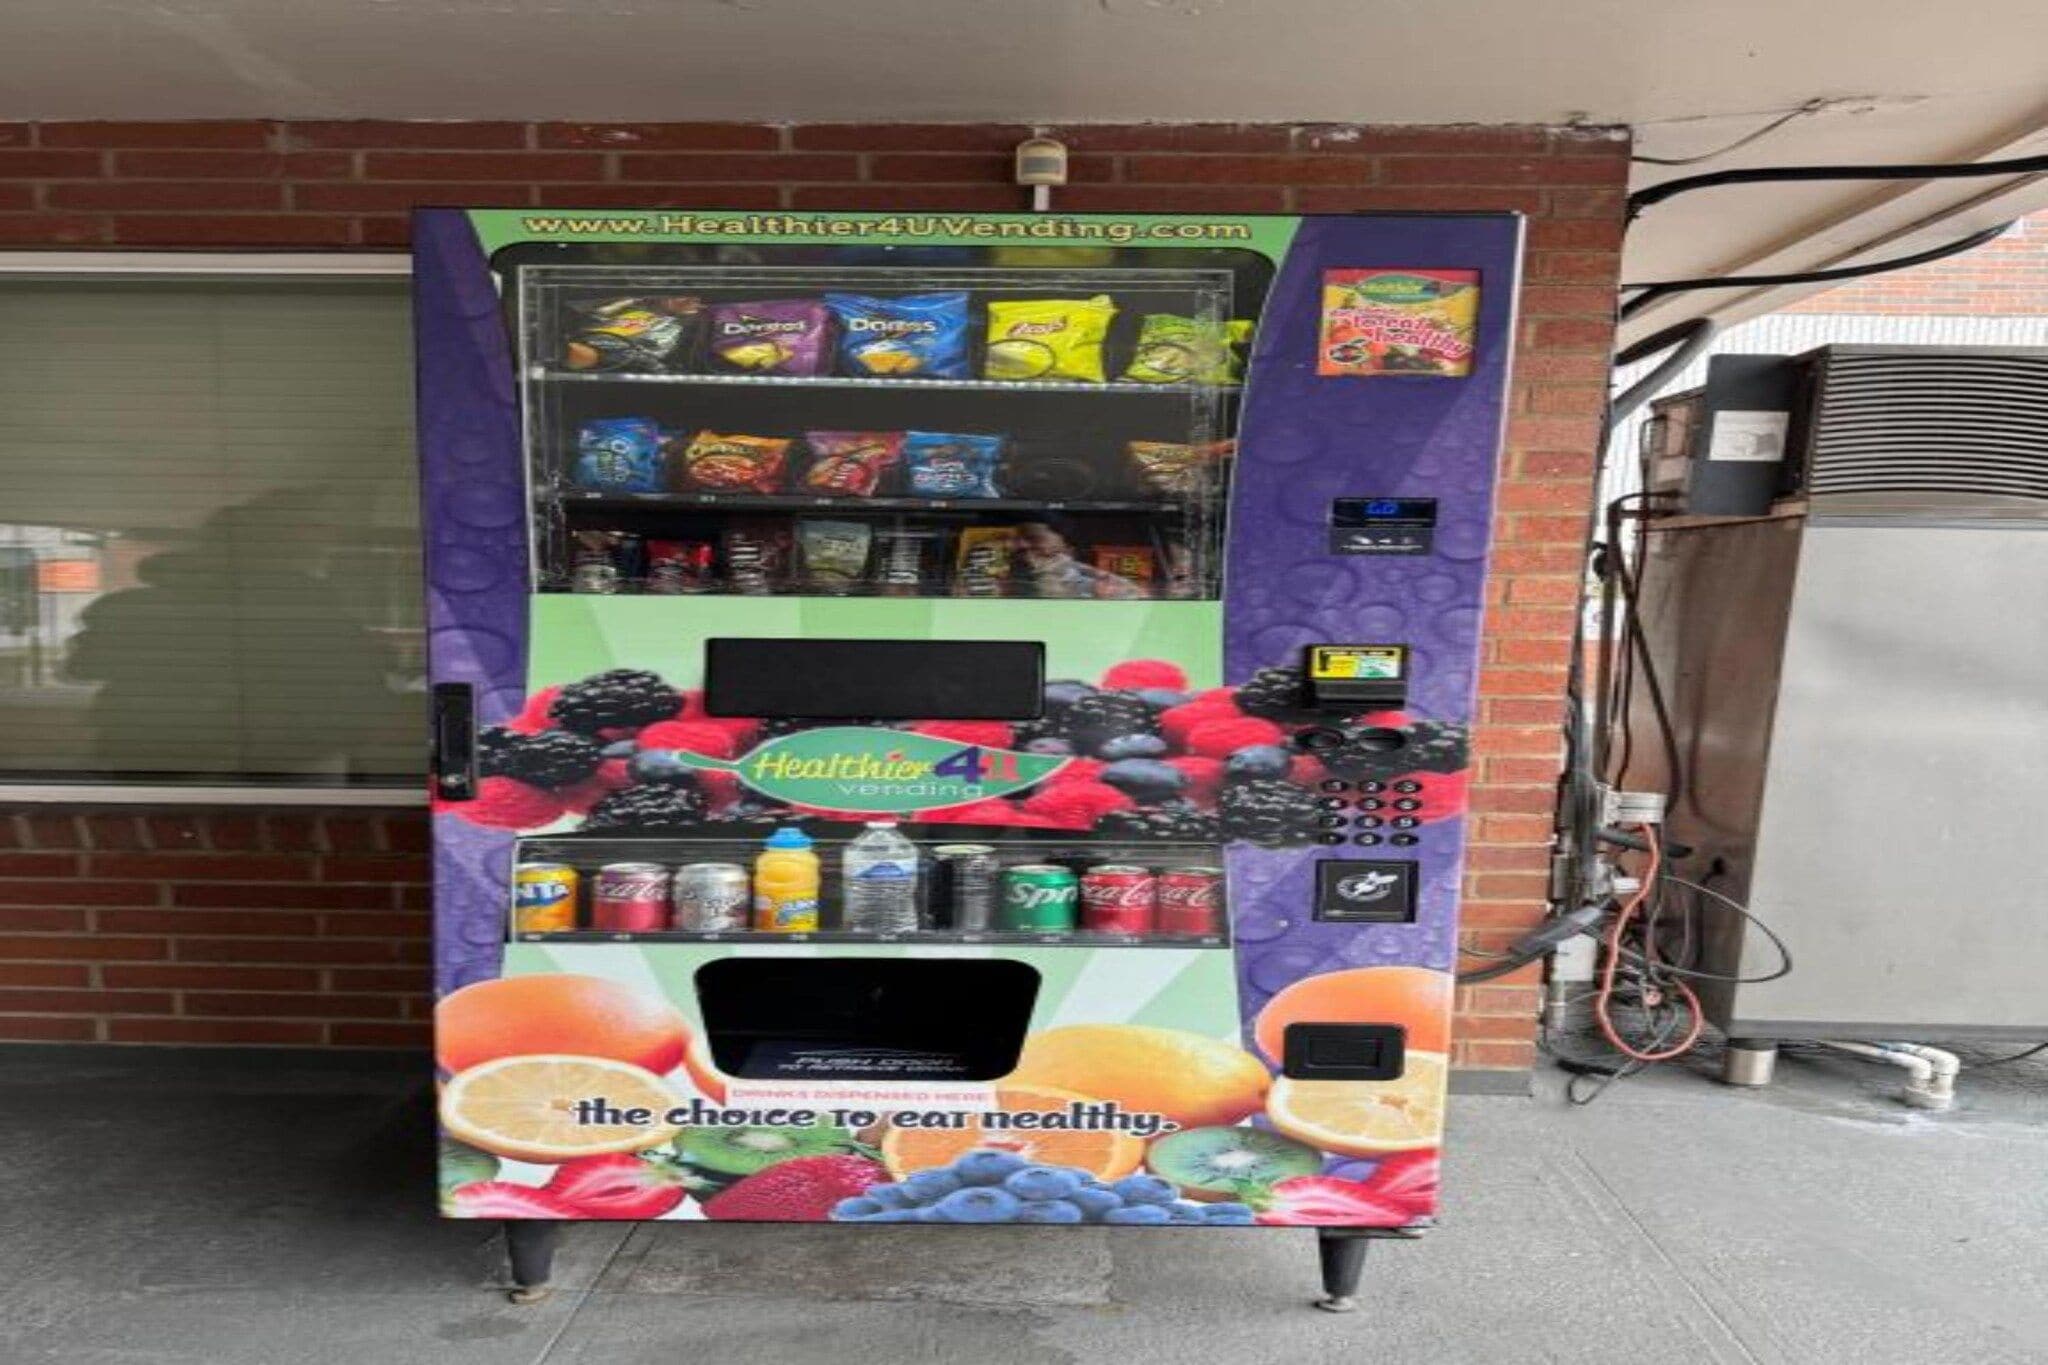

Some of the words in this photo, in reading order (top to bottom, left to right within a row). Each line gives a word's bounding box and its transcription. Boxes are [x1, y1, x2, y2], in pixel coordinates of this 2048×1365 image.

[524, 215, 1251, 241] www.Healthier4UVending.com
[754, 750, 933, 781] Healthier
[575, 1098, 650, 1126] the
[664, 1098, 816, 1127] choice
